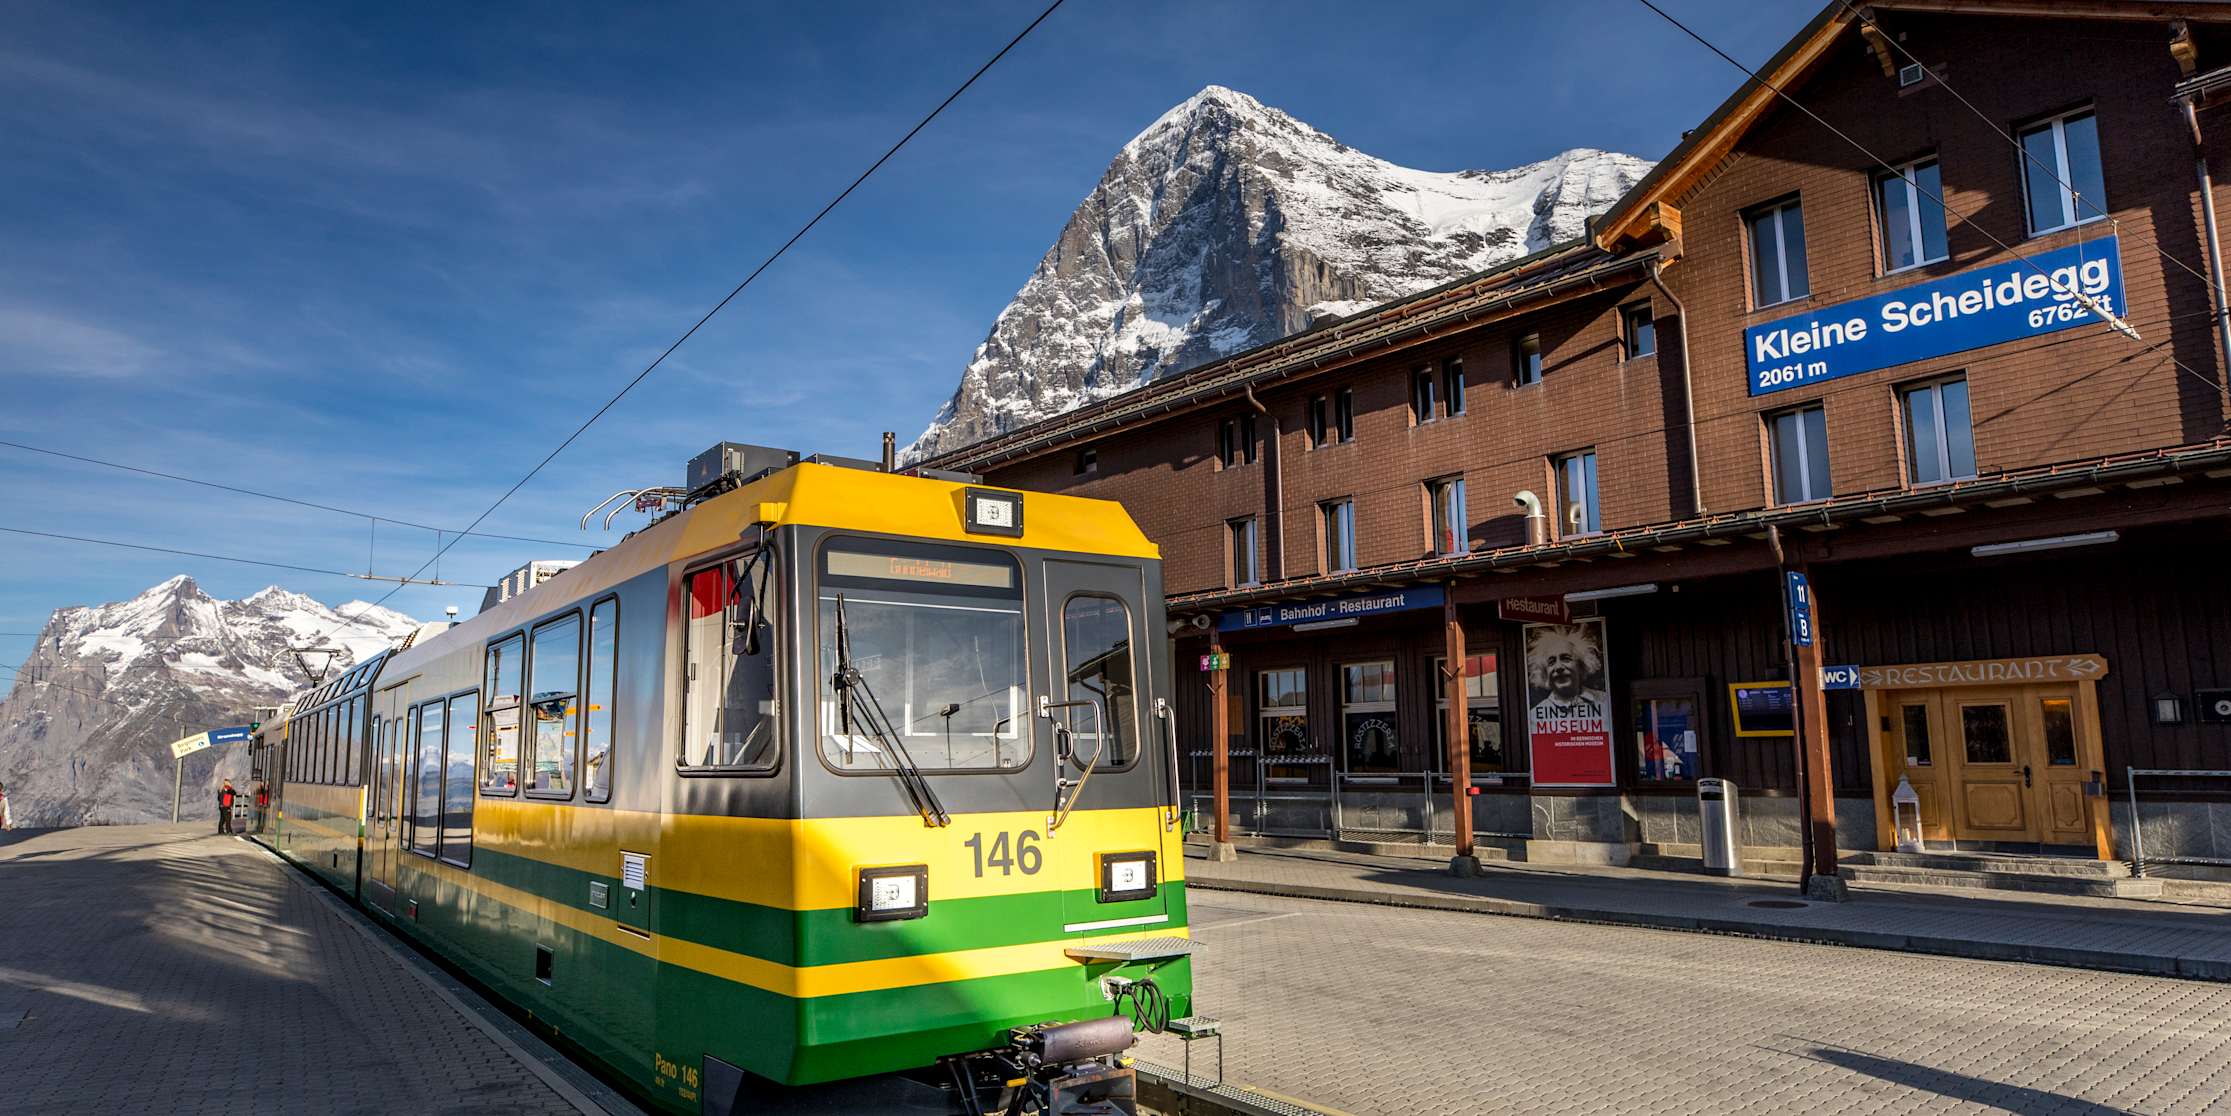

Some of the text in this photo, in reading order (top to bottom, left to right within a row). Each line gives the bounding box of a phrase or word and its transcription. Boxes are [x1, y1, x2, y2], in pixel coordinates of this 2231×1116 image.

[1755, 258, 2110, 363] Kleine Scheidegg
[2028, 302, 2089, 328] 6762
[1759, 361, 1827, 387] 2061 m
[1506, 597, 1560, 616] Restaurant
[1797, 585, 1805, 603] 11
[1280, 604, 1326, 621] Bahnhof
[1339, 593, 1406, 613] Restaurant
[1801, 619, 1808, 637] B
[1824, 671, 1847, 683] WC
[1887, 659, 2063, 684] RESTAURANT
[1536, 704, 1602, 719] EINSTEIN
[1536, 719, 1603, 734] MUSEUM
[964, 829, 1042, 878] 146
[655, 1052, 677, 1079] Pano
[681, 1064, 698, 1088] 146
